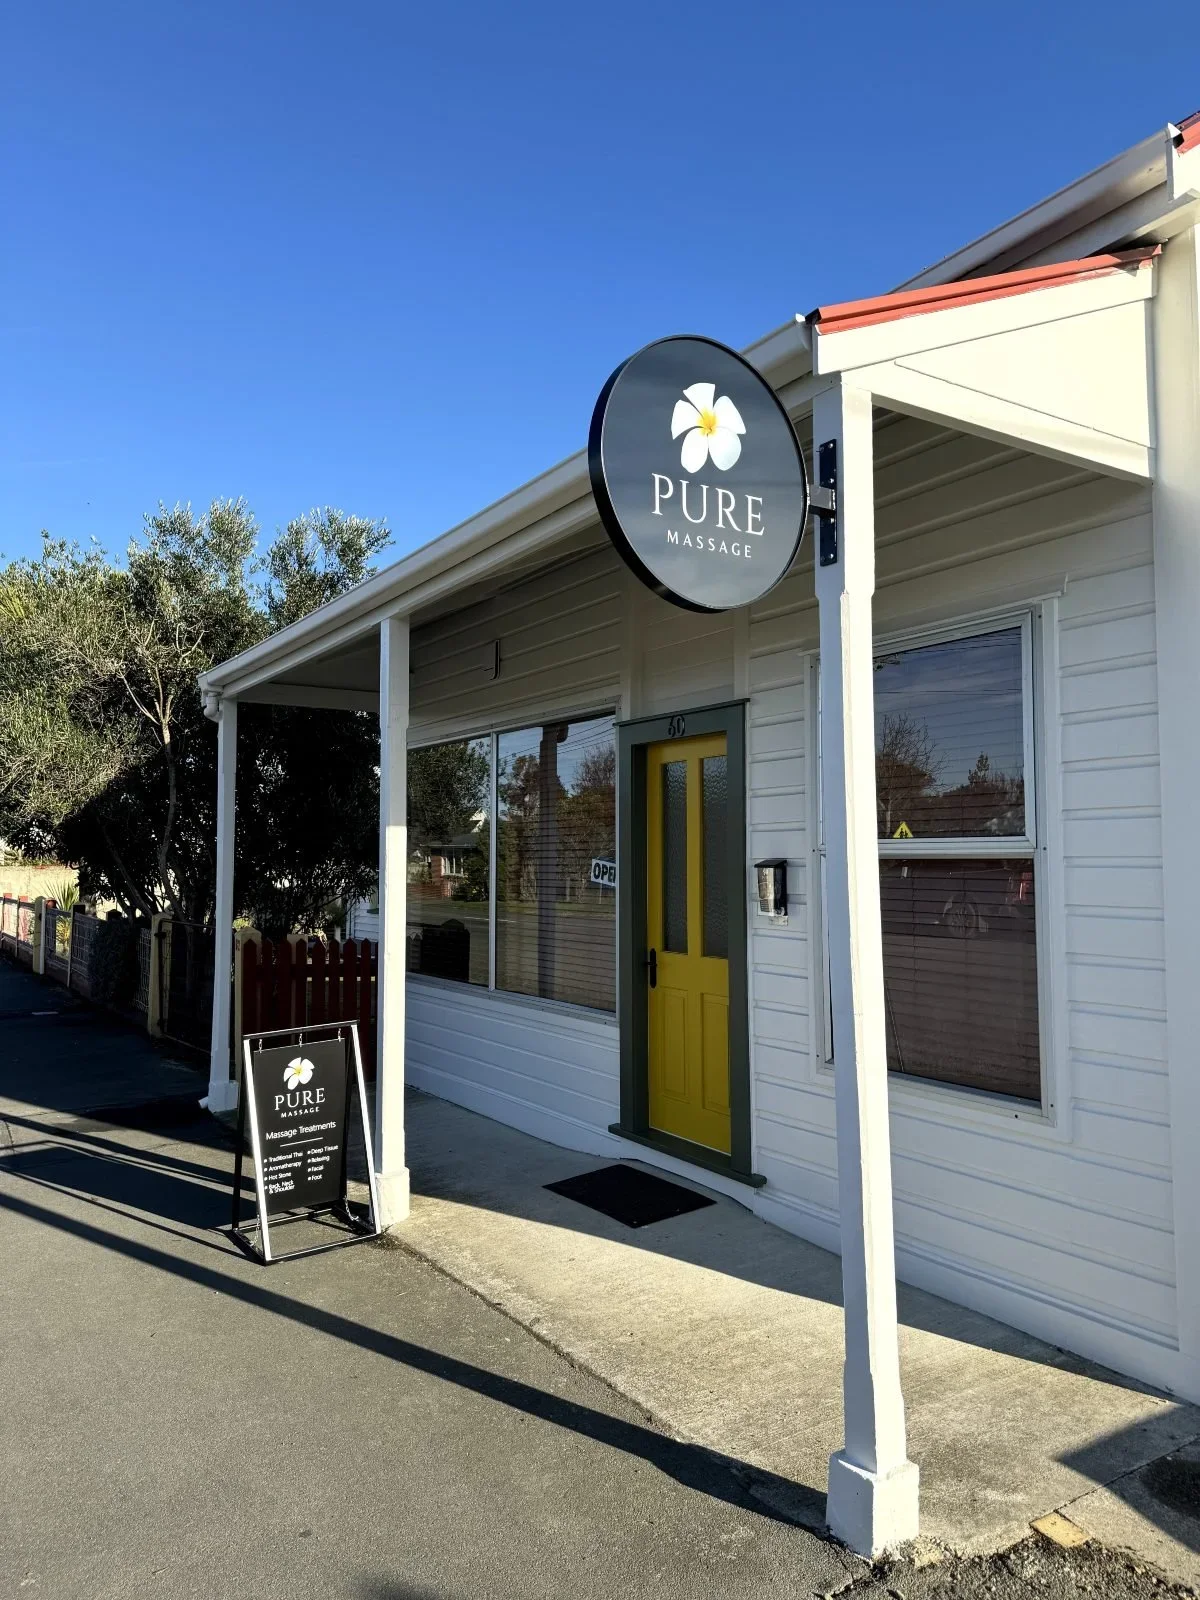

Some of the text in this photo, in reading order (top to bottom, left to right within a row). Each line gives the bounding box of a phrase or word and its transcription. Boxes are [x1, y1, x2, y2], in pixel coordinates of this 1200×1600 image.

[651, 473, 765, 536] PURE
[667, 529, 752, 558] MASSAGE
[668, 715, 685, 737] 60
[274, 1088, 326, 1111] PURE
[281, 1107, 320, 1118] MASSAGE
[266, 1121, 337, 1140] Massage Treatments
[269, 1153, 293, 1162] Traditional
[269, 1161, 302, 1171] Aromatherapy
